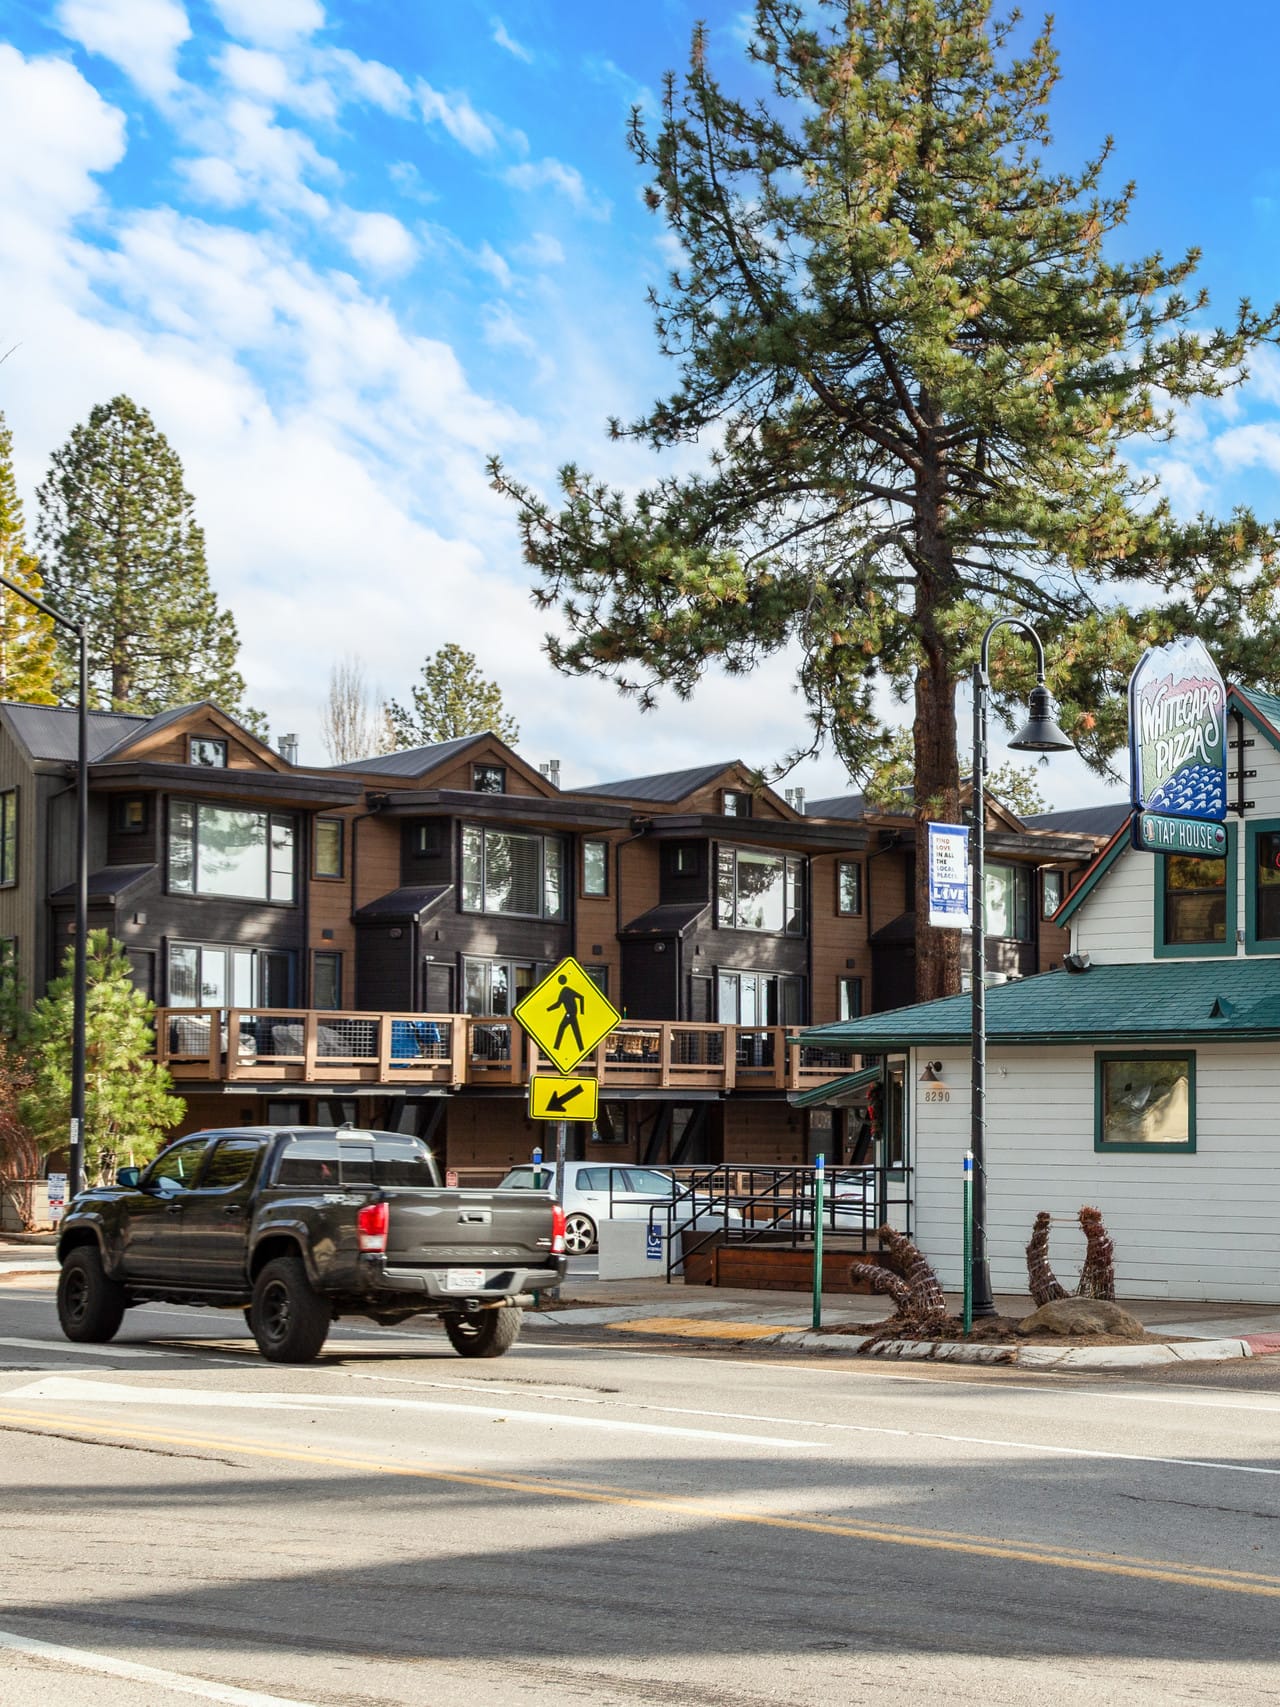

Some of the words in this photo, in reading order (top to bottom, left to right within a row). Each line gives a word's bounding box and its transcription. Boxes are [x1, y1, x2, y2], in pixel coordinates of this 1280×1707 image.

[1142, 685, 1220, 747] WHITECAPS
[1155, 724, 1211, 778] PIZZA
[1157, 820, 1176, 844] TAP
[1180, 823, 1213, 849] HOUSE
[925, 1091, 950, 1102] 8290
